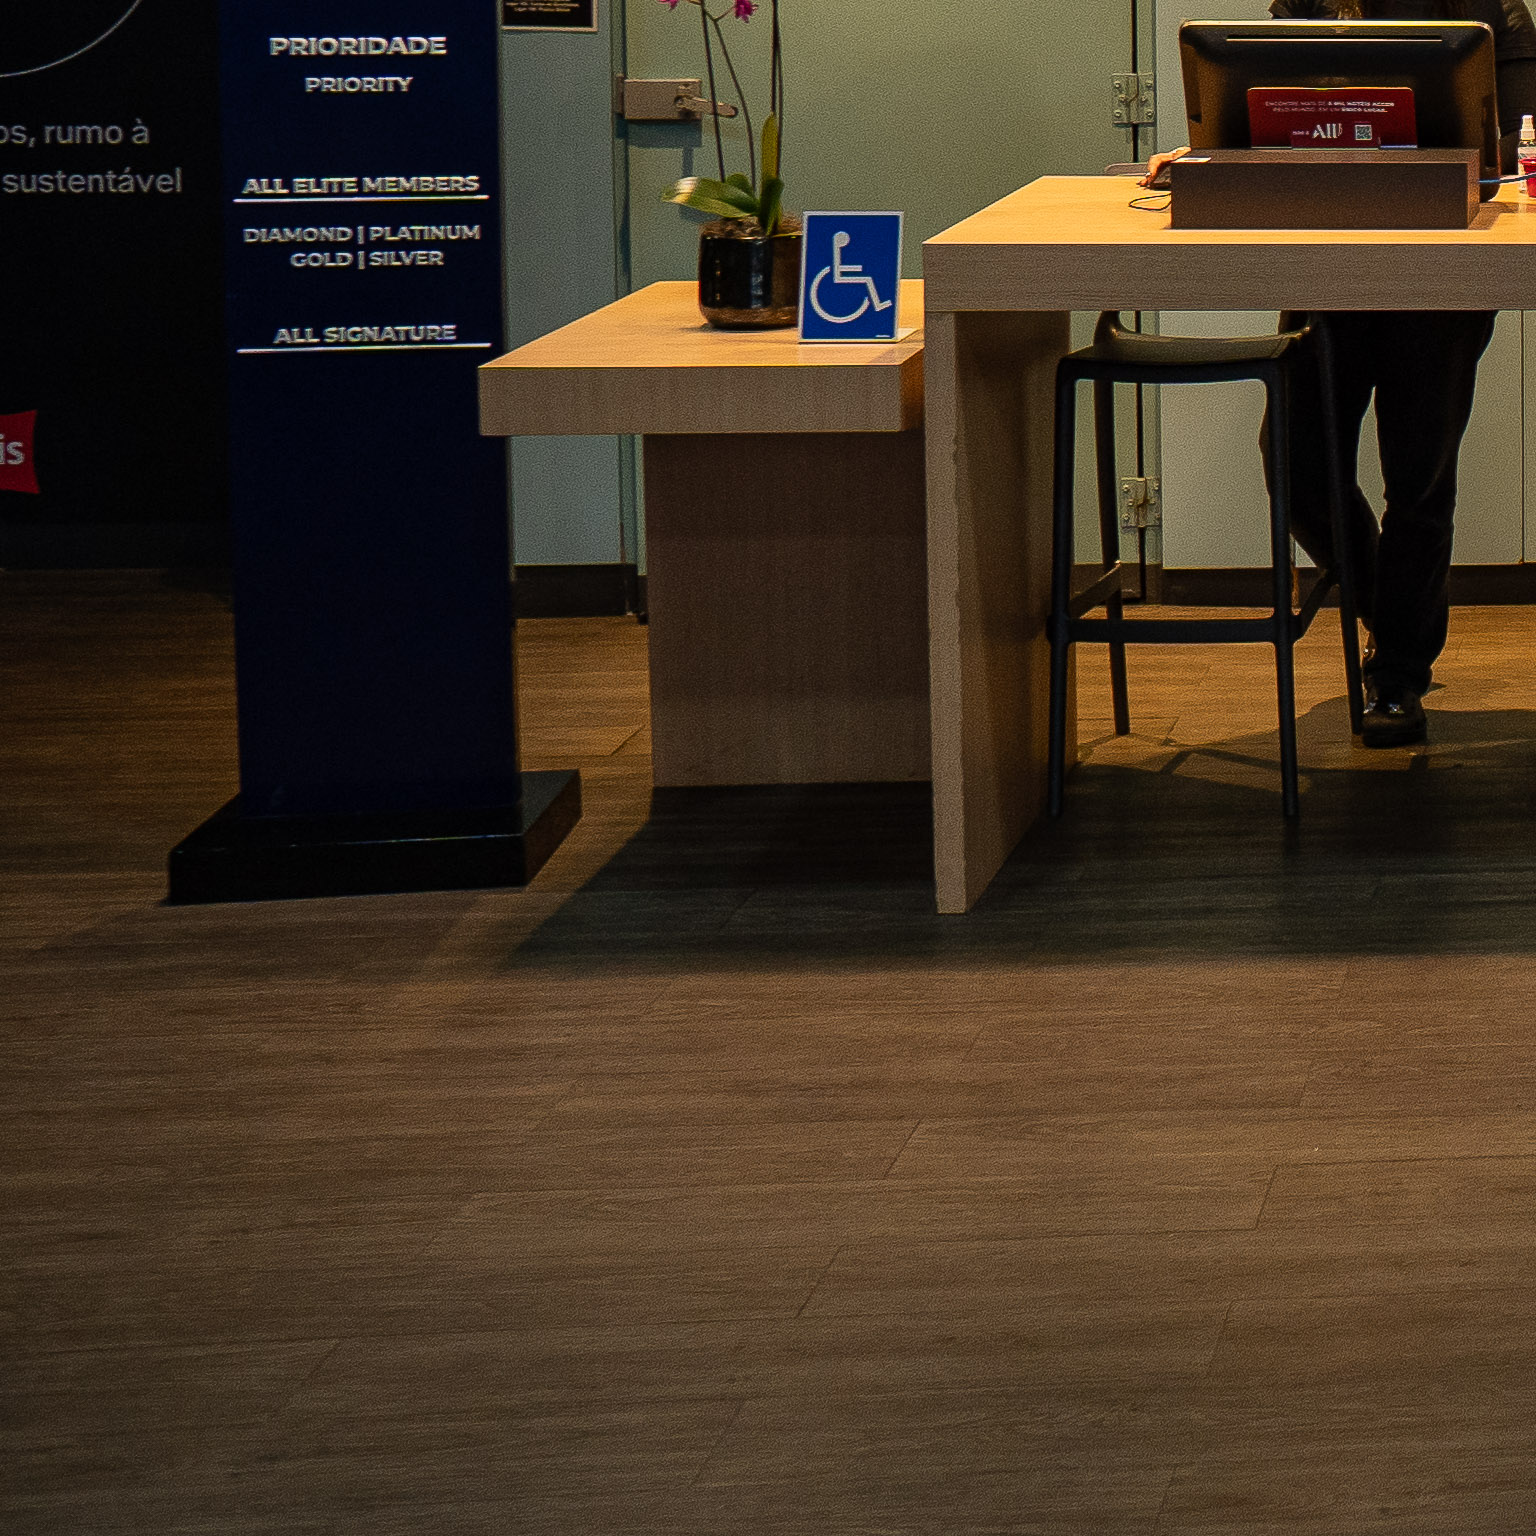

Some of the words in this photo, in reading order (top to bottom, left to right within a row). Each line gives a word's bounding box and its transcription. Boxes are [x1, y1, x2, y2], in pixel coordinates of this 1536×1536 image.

[269, 36, 447, 56] PRIORIDADE
[304, 76, 413, 93] PRIORITY
[44, 124, 124, 144] rumo
[132, 117, 150, 144] à
[2, 166, 183, 193] sustentável
[242, 178, 289, 194] ALL
[292, 177, 358, 194] ELITE
[362, 175, 480, 193] MEMBERS
[243, 227, 353, 242] DIAMOND
[368, 225, 481, 242] PLATINUM
[290, 252, 354, 267] GOLD
[368, 250, 445, 266] SILVER
[273, 327, 321, 344] ALL
[322, 324, 457, 343] SIGNATURE
